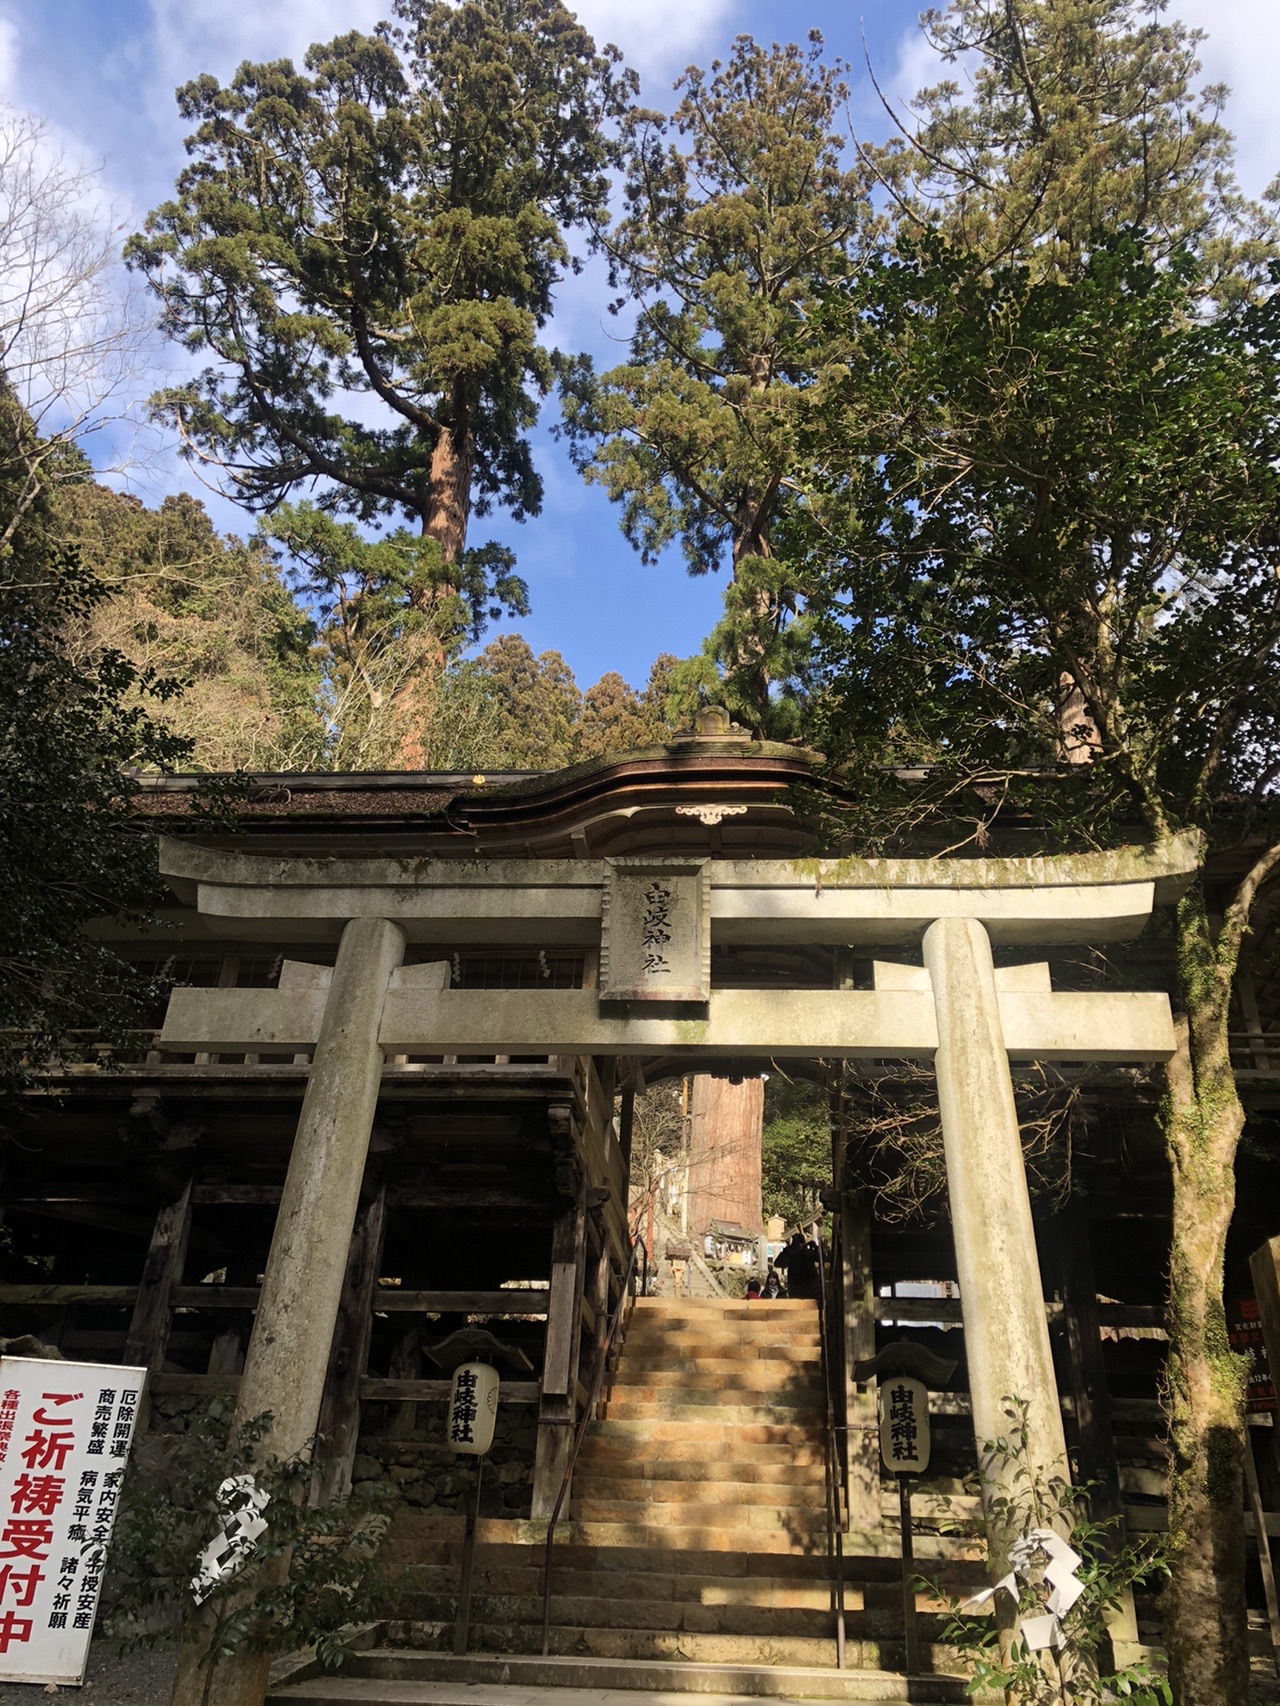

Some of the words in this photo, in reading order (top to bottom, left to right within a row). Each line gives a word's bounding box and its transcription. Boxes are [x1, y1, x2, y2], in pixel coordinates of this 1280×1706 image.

[641, 882, 672, 974] 由岐神社
[85, 1388, 117, 1456] 商売繁盛
[109, 1388, 138, 1459] 厄除開運
[451, 1369, 478, 1443] 由岐神社
[890, 1384, 919, 1462] 由岐神社
[0, 1392, 84, 1651] ご祈祷受付中
[67, 1470, 99, 1541] 病気平癒
[92, 1472, 121, 1542] 家内安全
[47, 1556, 79, 1630] 諸々祈願
